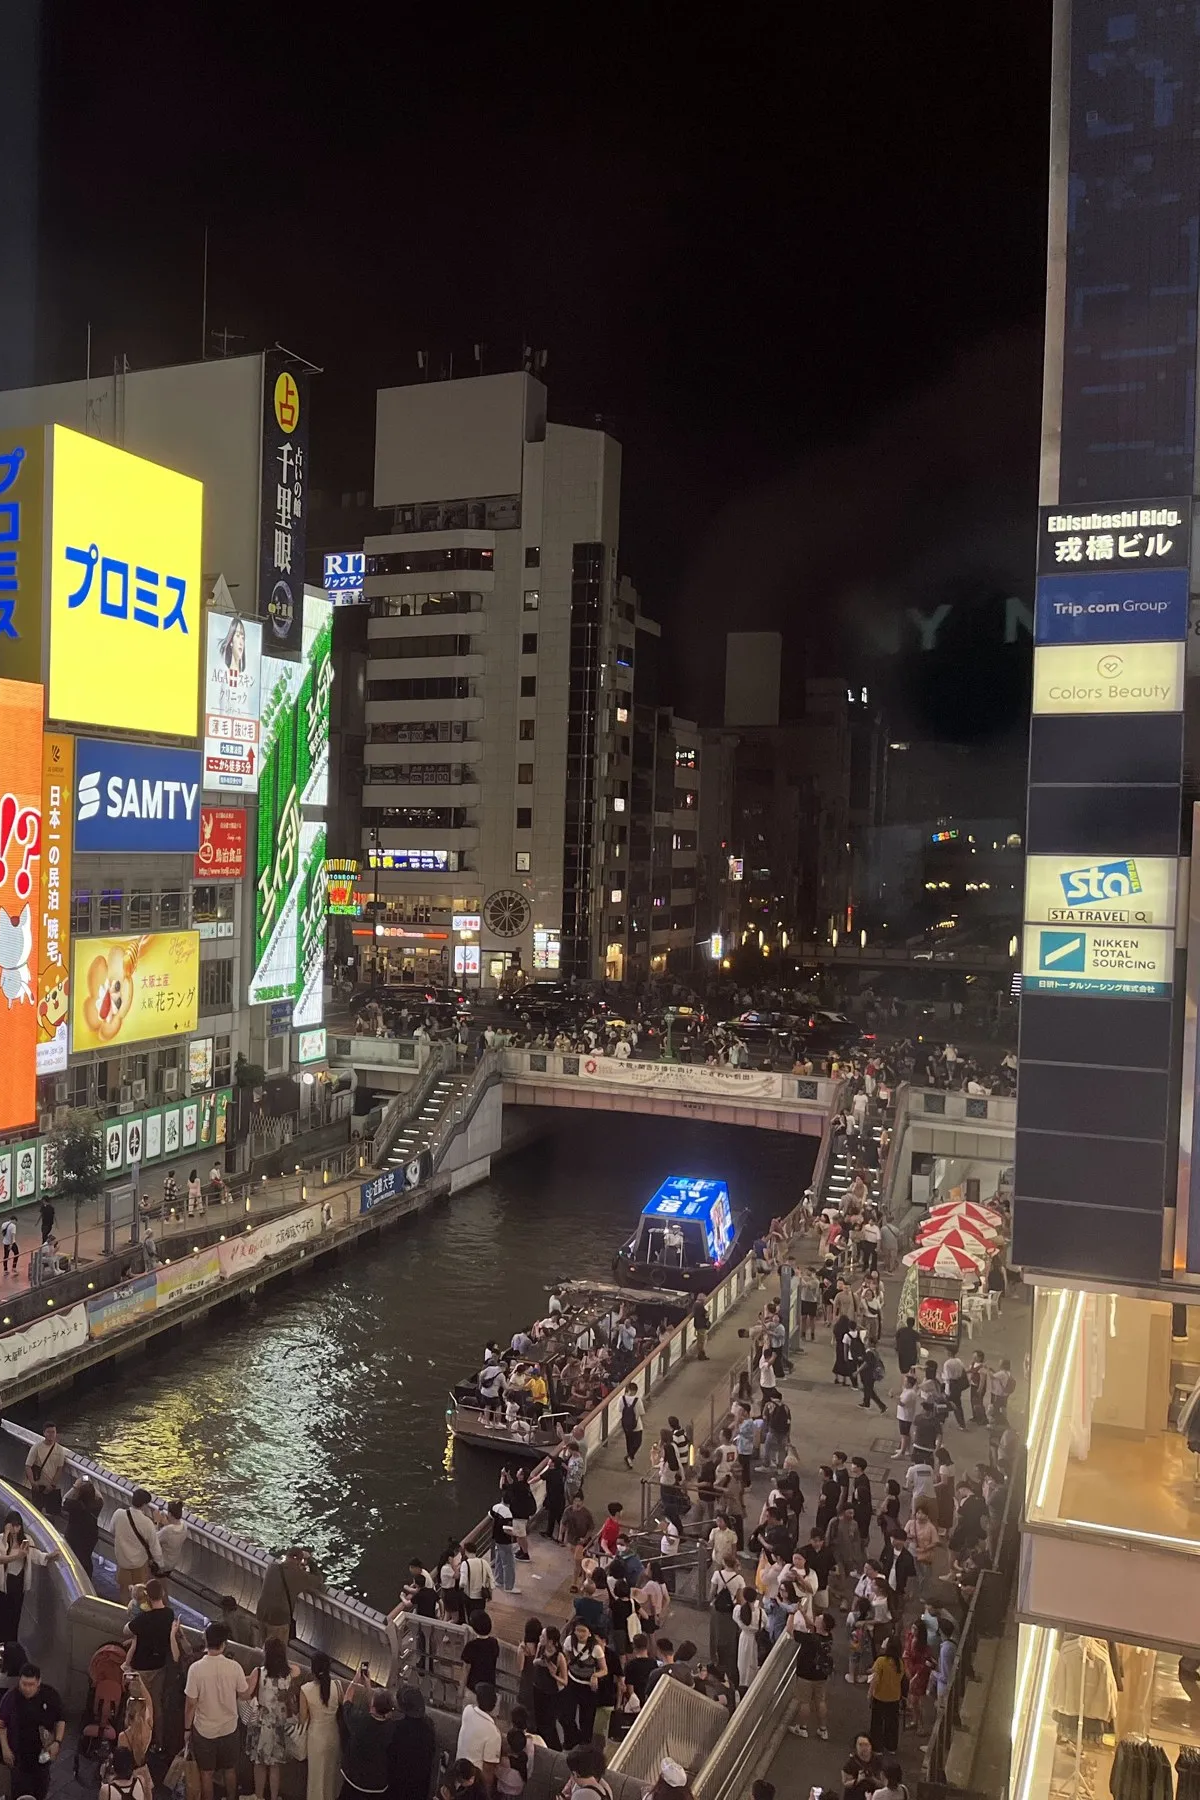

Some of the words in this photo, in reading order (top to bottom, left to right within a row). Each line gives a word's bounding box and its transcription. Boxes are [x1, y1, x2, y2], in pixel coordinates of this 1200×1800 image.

[280, 375, 294, 427] 占
[274, 441, 295, 575] 千里眼
[1047, 511, 1138, 532] Ebisubashi
[1140, 509, 1181, 527] Bldg.
[1055, 533, 1173, 562] 戎橋ビル
[65, 543, 189, 634] プロミス
[1054, 601, 1120, 616] Trip.com
[1123, 600, 1168, 613] Group
[211, 669, 229, 684] AGA
[238, 673, 256, 688] スキン
[219, 688, 248, 704] クリニック
[1049, 686, 1103, 700] Colors
[1108, 684, 1171, 701] Beauty
[107, 776, 199, 820] SAMTY
[1067, 867, 1130, 898] sta
[1125, 860, 1141, 892] TRAVEL
[1051, 910, 1075, 920] STA
[1078, 911, 1126, 922] TRAVEL
[1093, 939, 1139, 948] NIKKEN
[1093, 949, 1132, 959] TOTAL
[1092, 959, 1156, 970] SOURCING
[1039, 980, 1156, 994] 日研トータルソーシング株式会社
